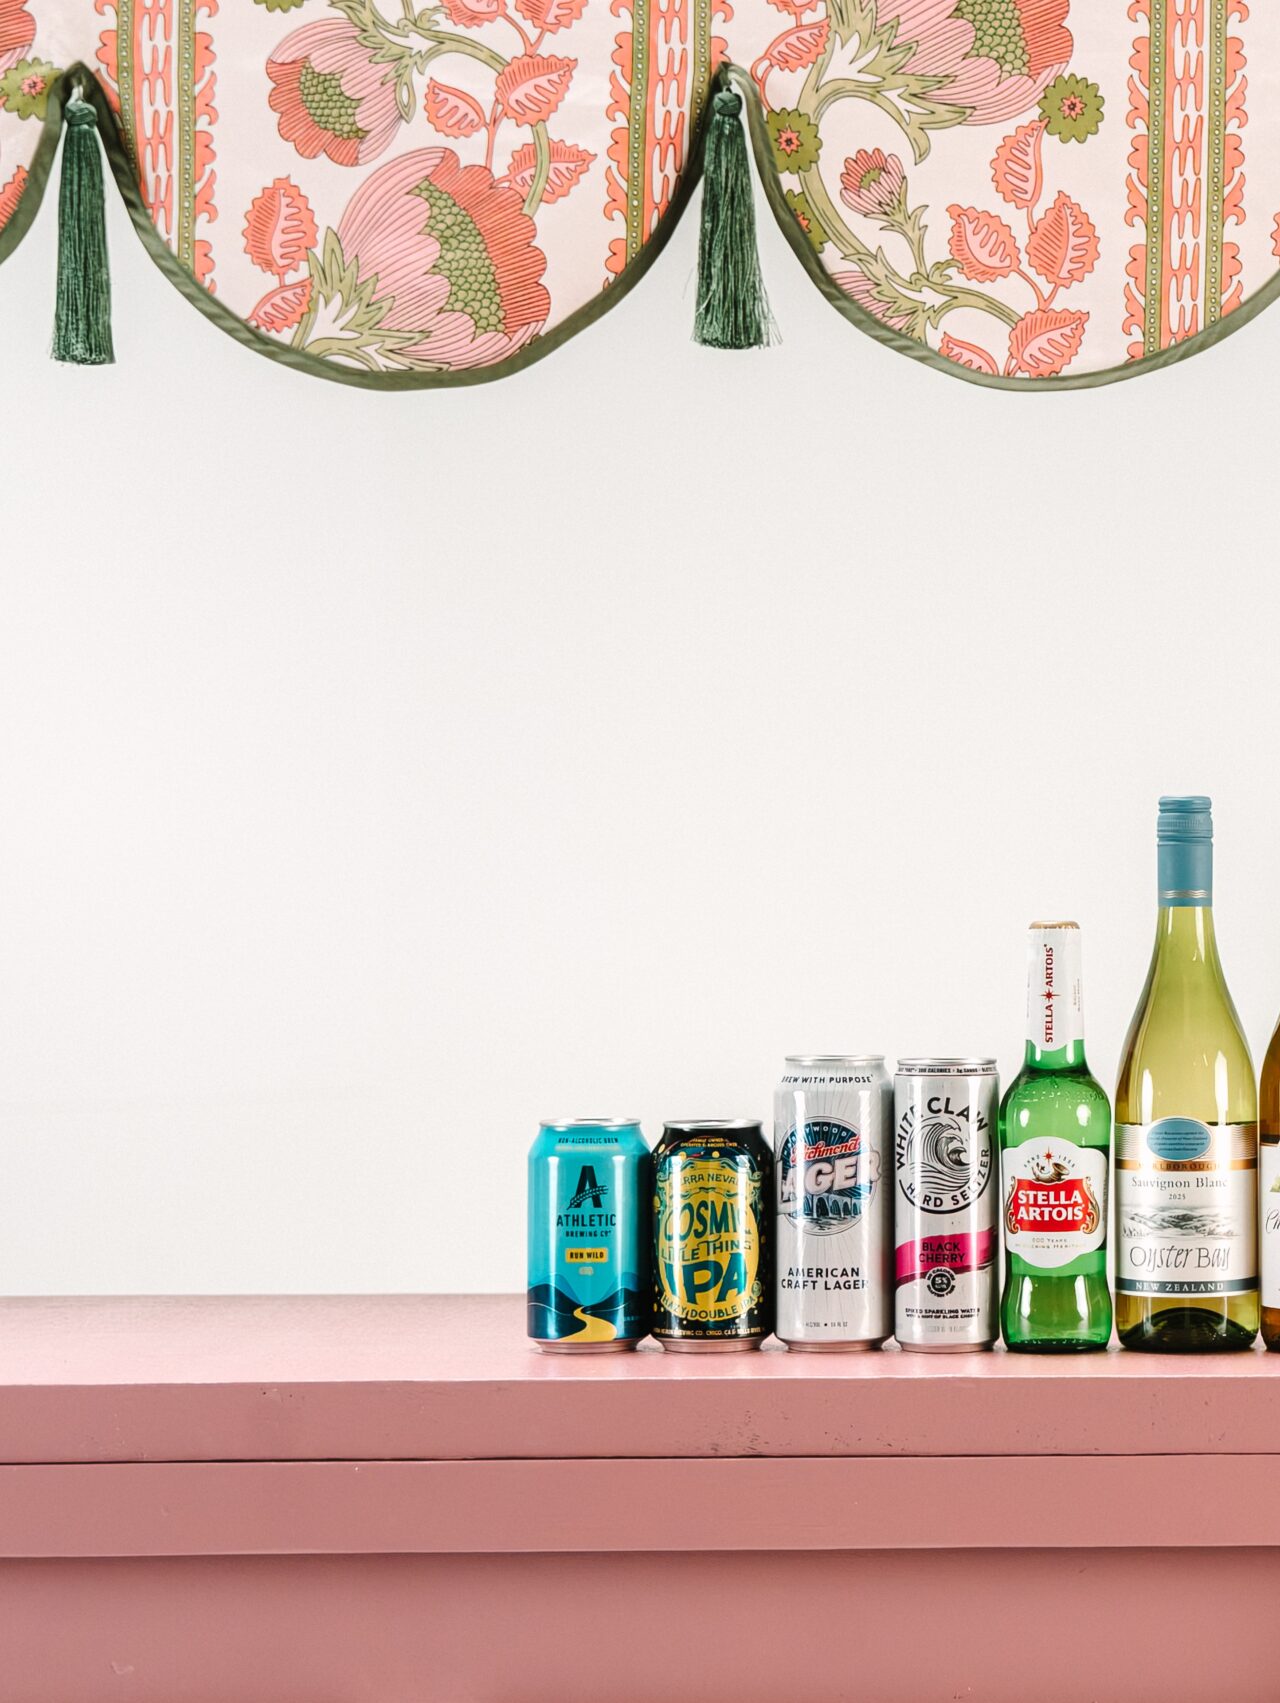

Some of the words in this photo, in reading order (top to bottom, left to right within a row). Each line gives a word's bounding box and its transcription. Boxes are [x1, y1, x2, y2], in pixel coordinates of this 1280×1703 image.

[1045, 946, 1053, 987] ARTOIS
[1045, 1004, 1053, 1043] STELLA
[829, 1076, 872, 1084] PURPOSE
[927, 1097, 989, 1132] CLAW
[1131, 1177, 1190, 1191] Sauvignon
[1196, 1177, 1228, 1189] Blanc
[906, 1182, 943, 1208] HRD
[1017, 1190, 1083, 1205] STELLA
[556, 1214, 616, 1227] ATHLETIC
[1017, 1206, 1083, 1221] ARTOIS
[566, 1230, 598, 1238] BREWING
[661, 1243, 700, 1262] LILE
[922, 1242, 960, 1252] BLACK
[570, 1251, 584, 1259] RUN
[586, 1251, 604, 1259] WILD
[919, 1253, 966, 1263] CHERRY
[1130, 1245, 1193, 1272] Oyster
[1194, 1247, 1230, 1271] Bay
[664, 1252, 747, 1306] IPA
[788, 1267, 860, 1278] AMERICAN
[781, 1279, 818, 1291] CRAFT
[1135, 1282, 1159, 1291] NEW
[1165, 1281, 1224, 1292] ZEALAND
[663, 1295, 687, 1314] HAZY
[690, 1305, 738, 1320] DOUBLE
